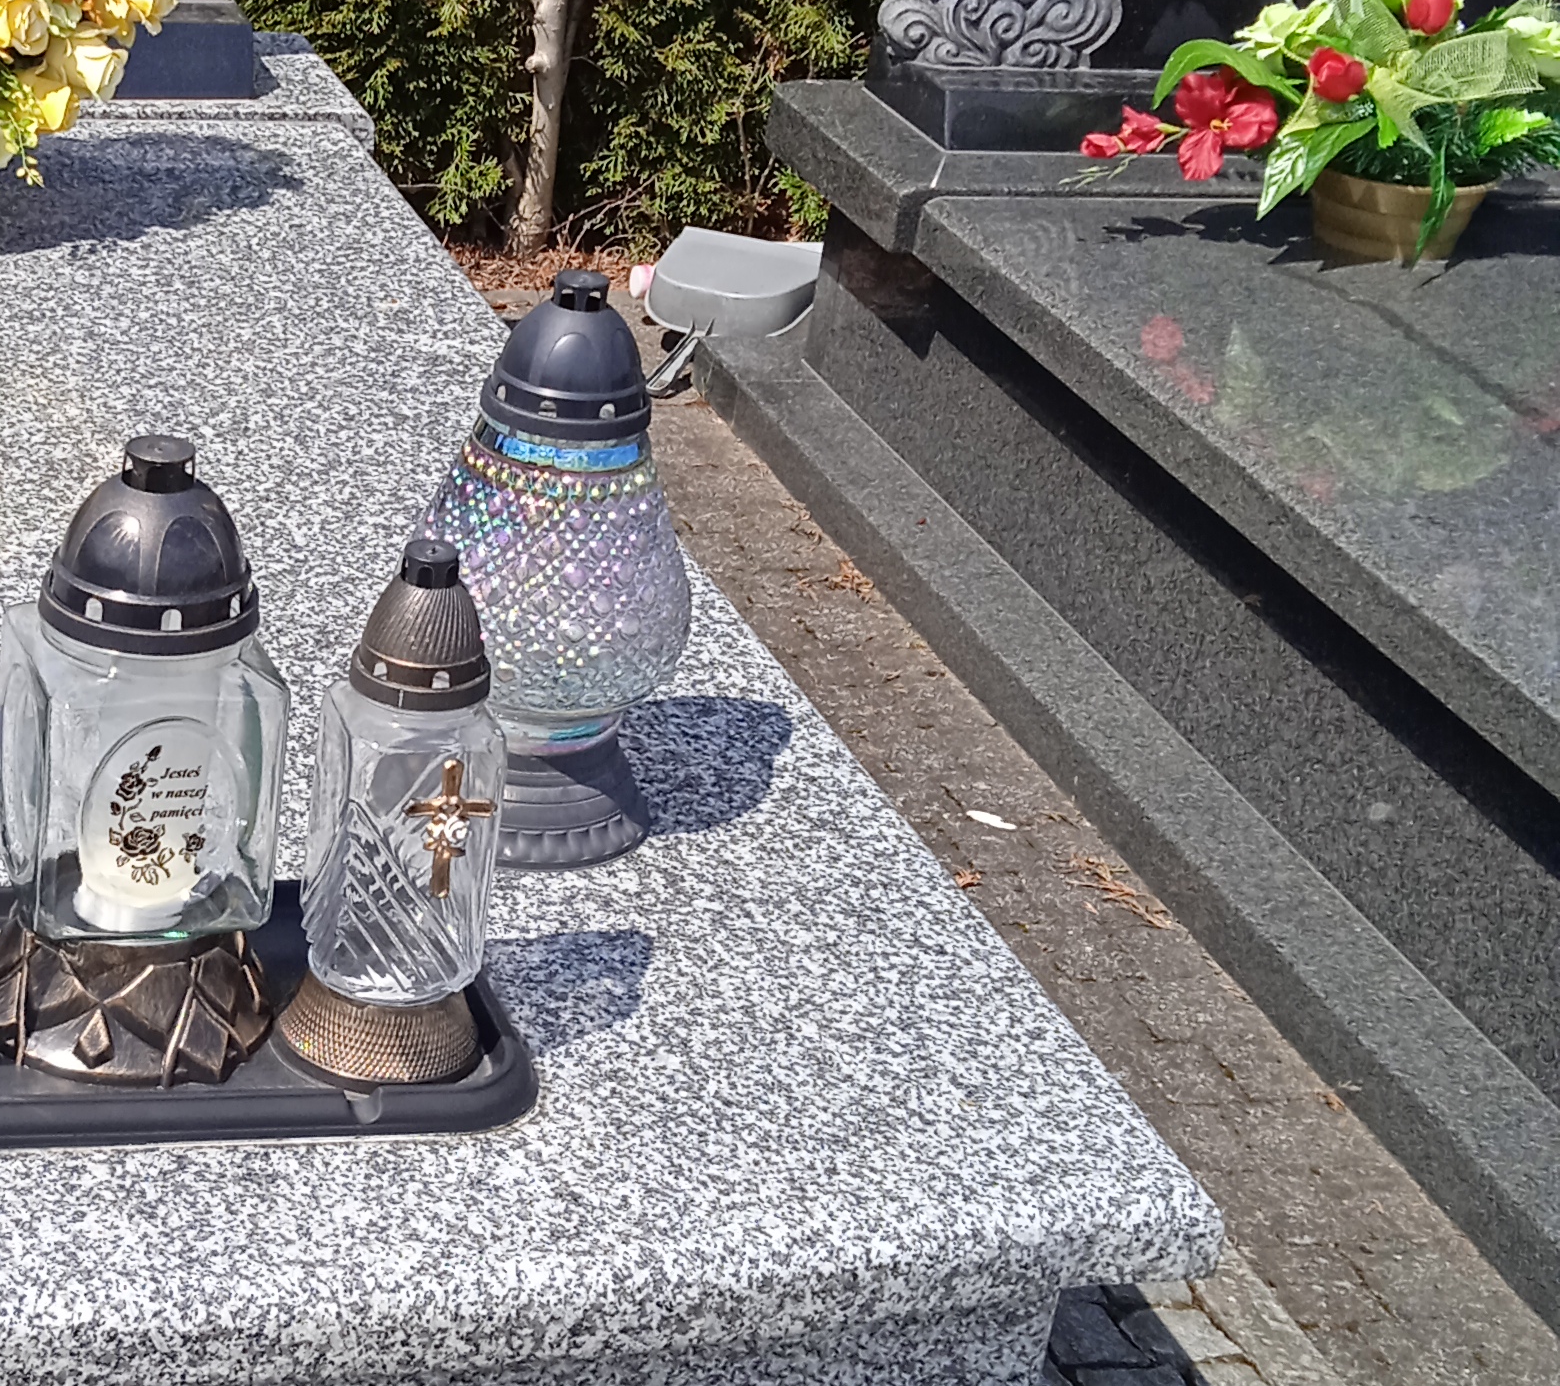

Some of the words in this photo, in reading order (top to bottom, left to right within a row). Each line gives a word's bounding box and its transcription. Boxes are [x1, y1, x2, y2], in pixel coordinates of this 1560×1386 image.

[160, 765, 202, 779] Jesteś
[151, 791, 163, 799] w
[165, 784, 209, 800] naszej
[149, 803, 205, 822] pamięci
